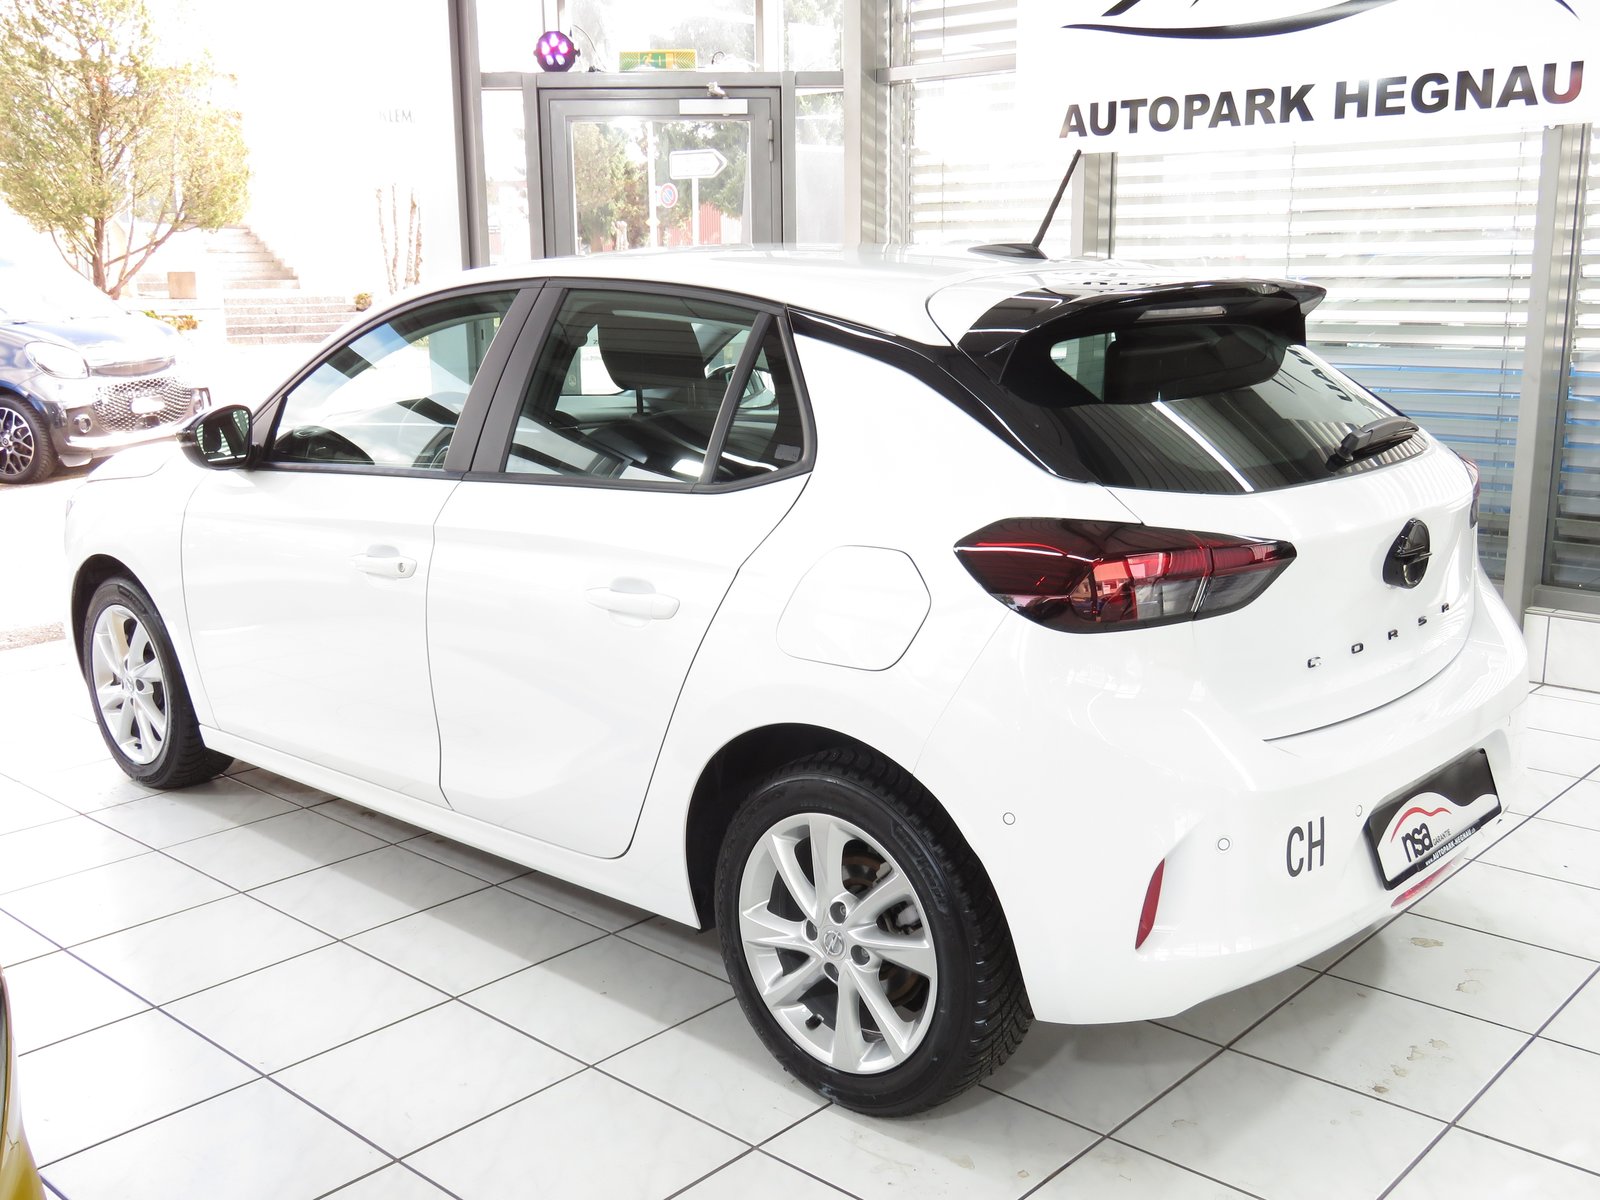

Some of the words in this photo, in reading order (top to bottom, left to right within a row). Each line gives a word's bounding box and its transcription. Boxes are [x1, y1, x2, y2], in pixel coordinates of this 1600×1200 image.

[1059, 84, 1314, 138] AUTOPARK
[1334, 60, 1584, 120] HEGNAU
[1307, 602, 1450, 668] CORSA
[1286, 816, 1324, 877] CH
[1401, 823, 1433, 863] nsa
